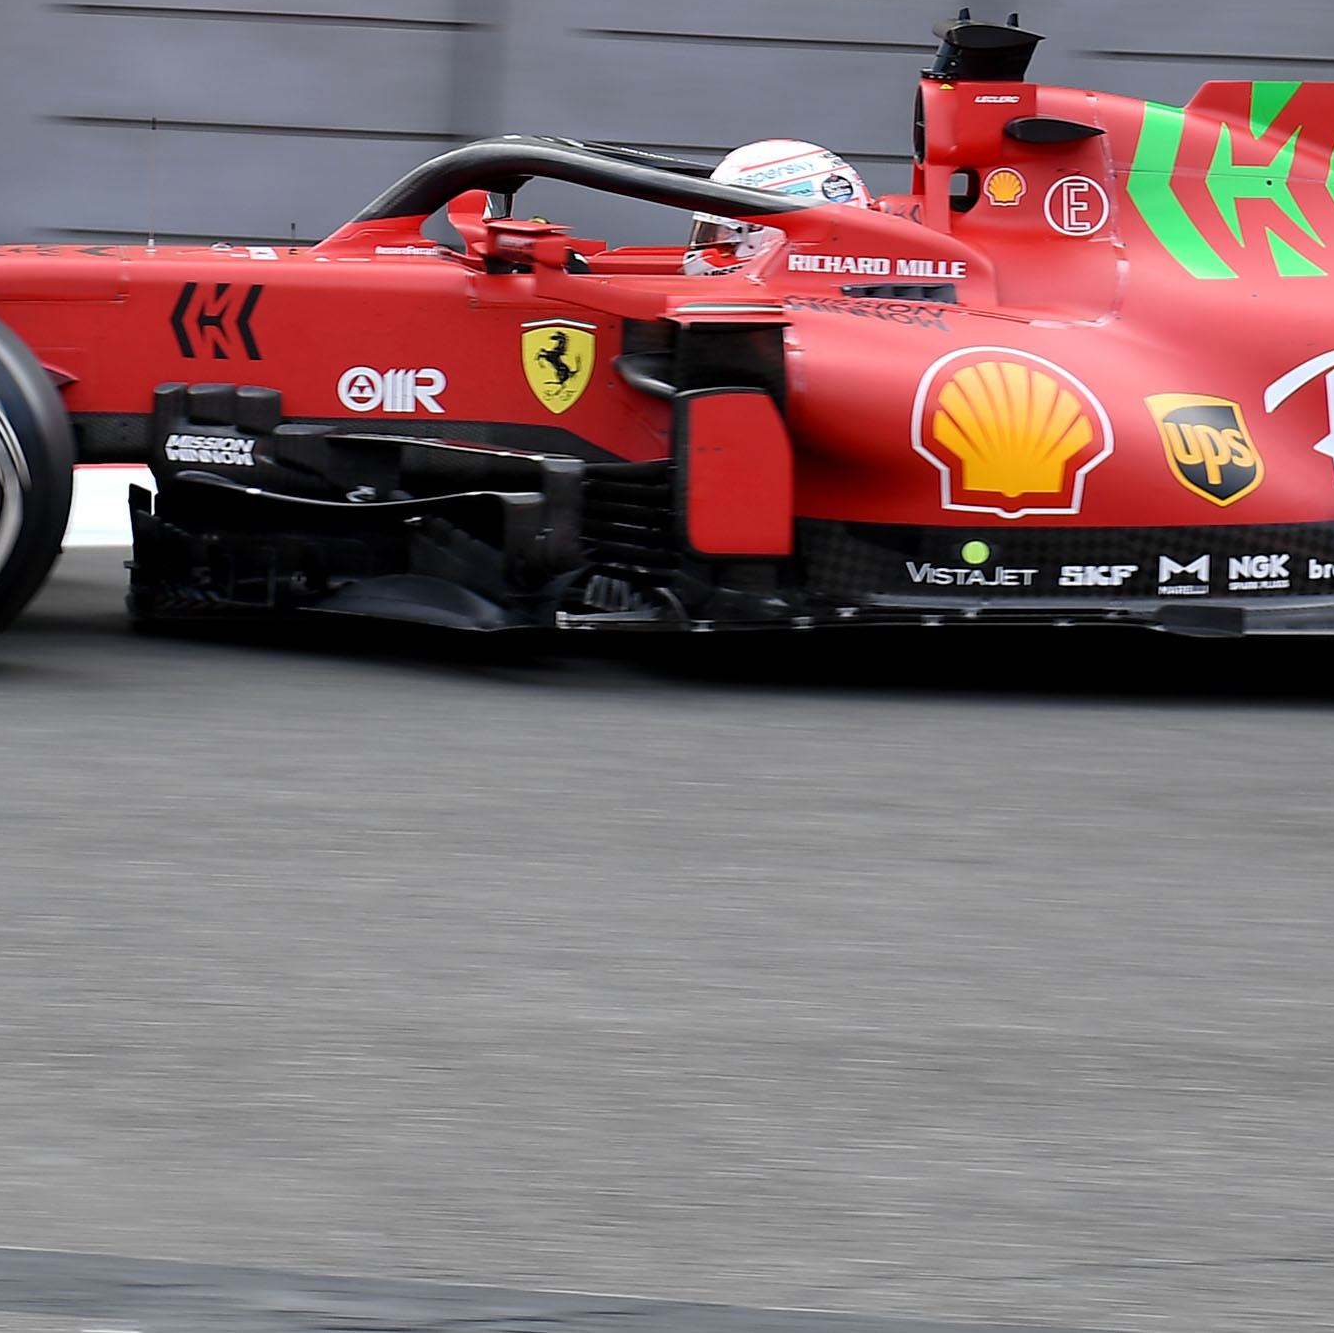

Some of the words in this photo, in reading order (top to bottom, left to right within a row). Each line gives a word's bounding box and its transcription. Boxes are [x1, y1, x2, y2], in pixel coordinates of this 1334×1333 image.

[787, 254, 891, 275] RICHARD
[896, 259, 967, 279] MILLE
[165, 434, 256, 453] MISSION
[1058, 565, 1139, 586] SKF
[1228, 554, 1291, 580] NGK
